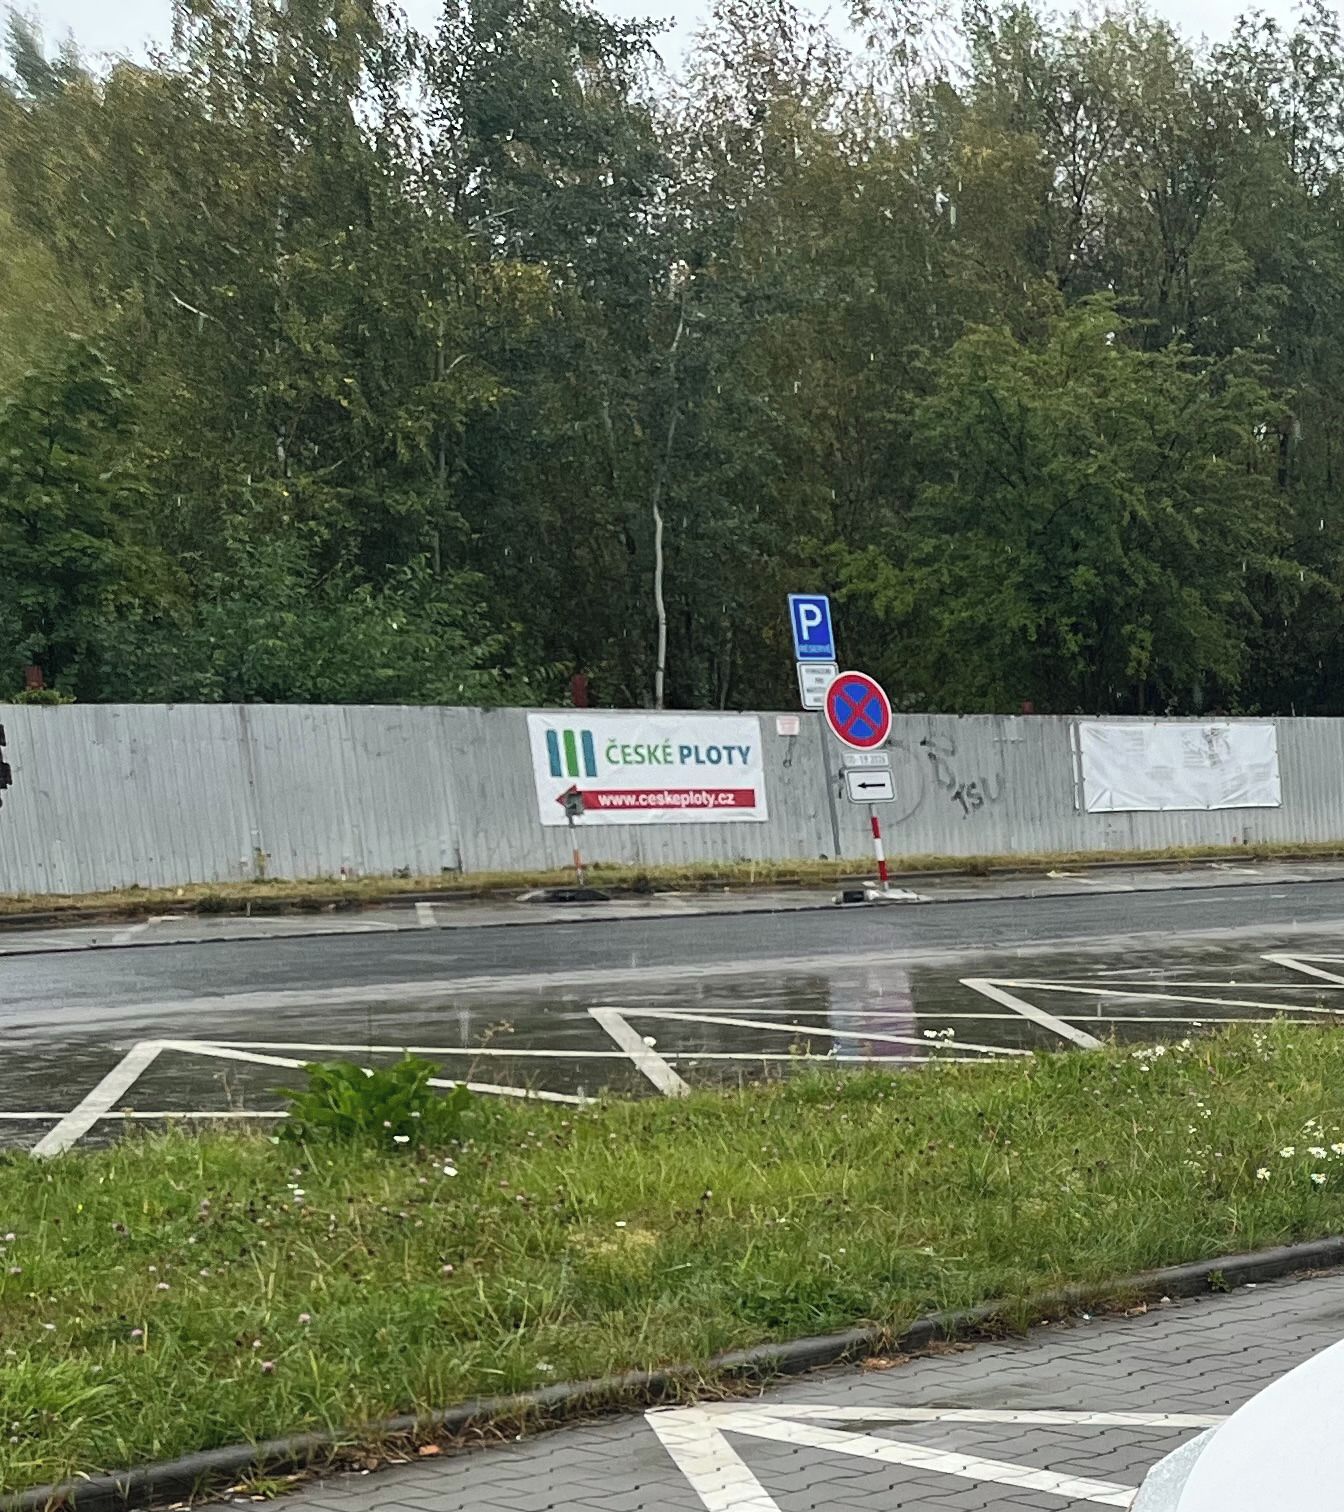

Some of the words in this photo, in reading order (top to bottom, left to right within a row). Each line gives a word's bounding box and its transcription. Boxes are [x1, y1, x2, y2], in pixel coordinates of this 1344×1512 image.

[799, 603, 823, 640] P
[606, 738, 674, 765] ČESKÉ
[679, 745, 751, 765] PLOTY
[597, 790, 736, 808] www.ceskeploty.cz
